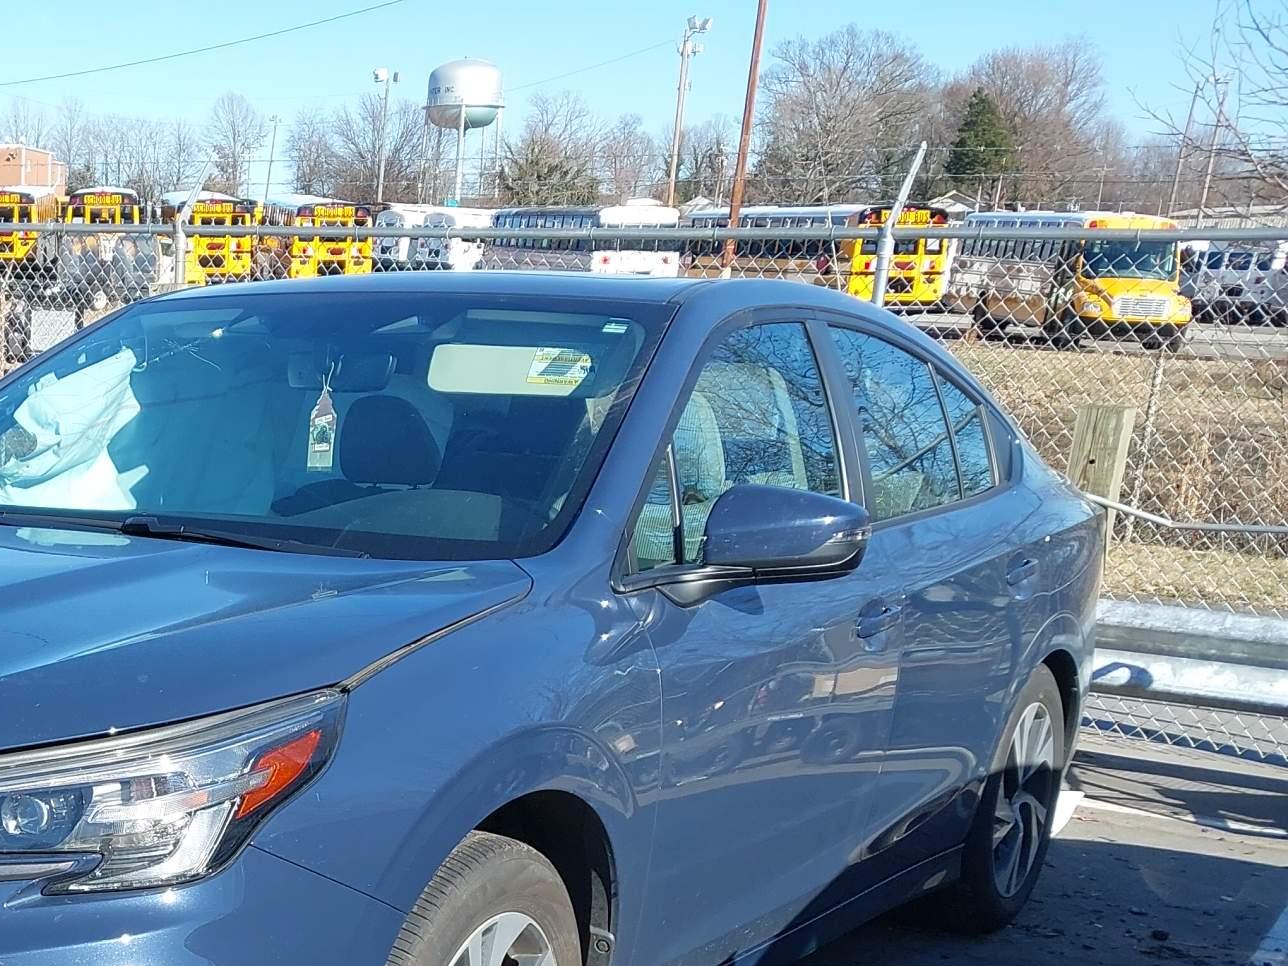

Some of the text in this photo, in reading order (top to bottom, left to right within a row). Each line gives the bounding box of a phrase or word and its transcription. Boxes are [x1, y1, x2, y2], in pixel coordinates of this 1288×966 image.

[85, 195, 121, 205] SCHOOL BUS
[194, 203, 220, 214] SCHOOL
[315, 206, 354, 218] SCHOOL BUS
[914, 211, 929, 223] BUS
